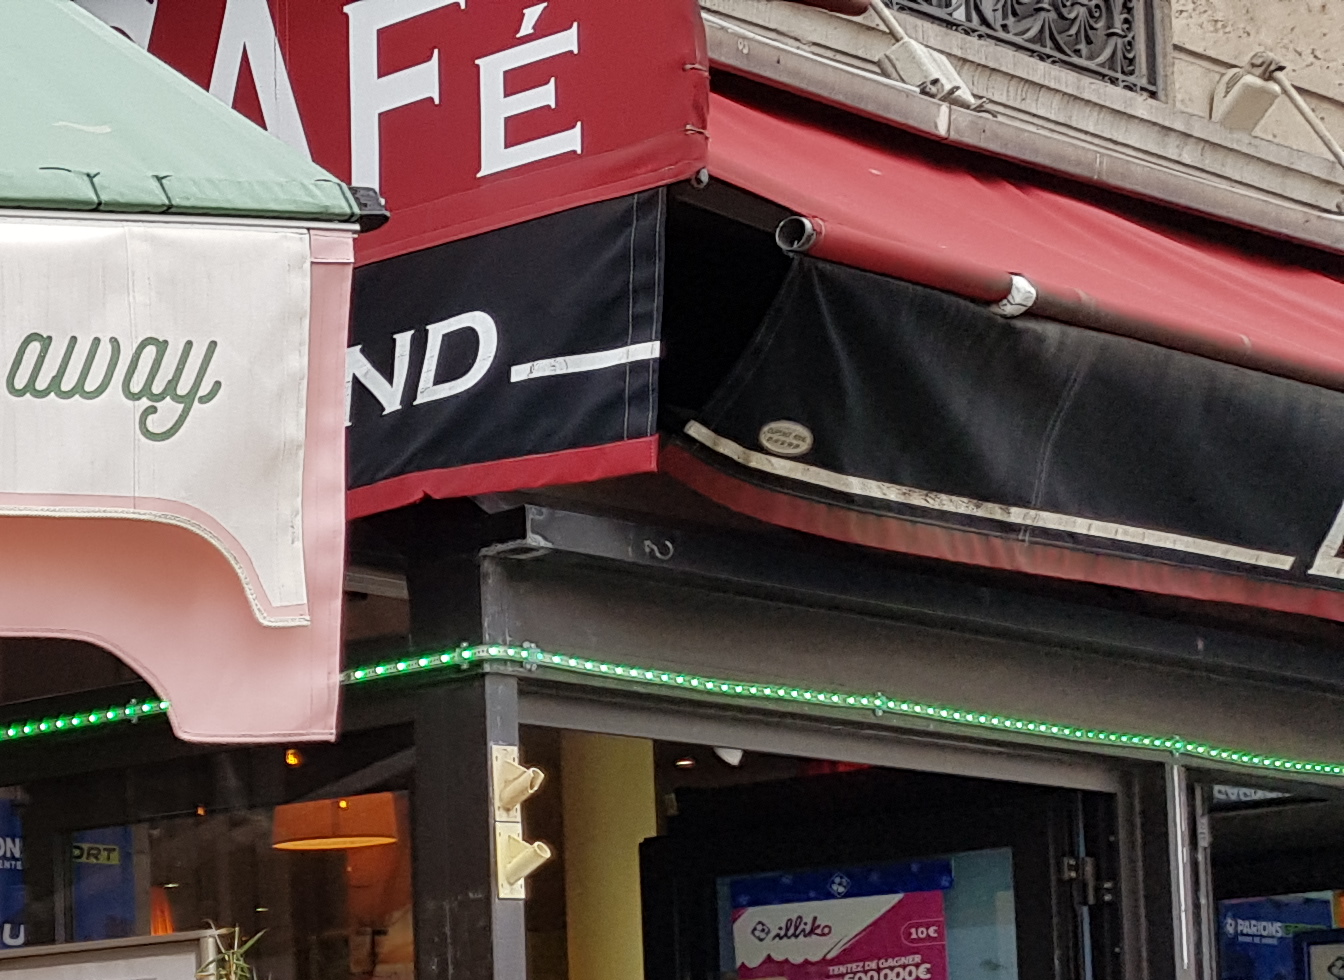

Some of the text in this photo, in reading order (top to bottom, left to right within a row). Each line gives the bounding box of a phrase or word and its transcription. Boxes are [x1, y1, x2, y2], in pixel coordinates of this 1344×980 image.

[67, 0, 583, 196] AFÉ
[5, 331, 222, 443] away
[771, 914, 833, 942] illiko
[909, 925, 939, 940] 10€
[828, 954, 922, 976] TENTEZ DE GAGNER
